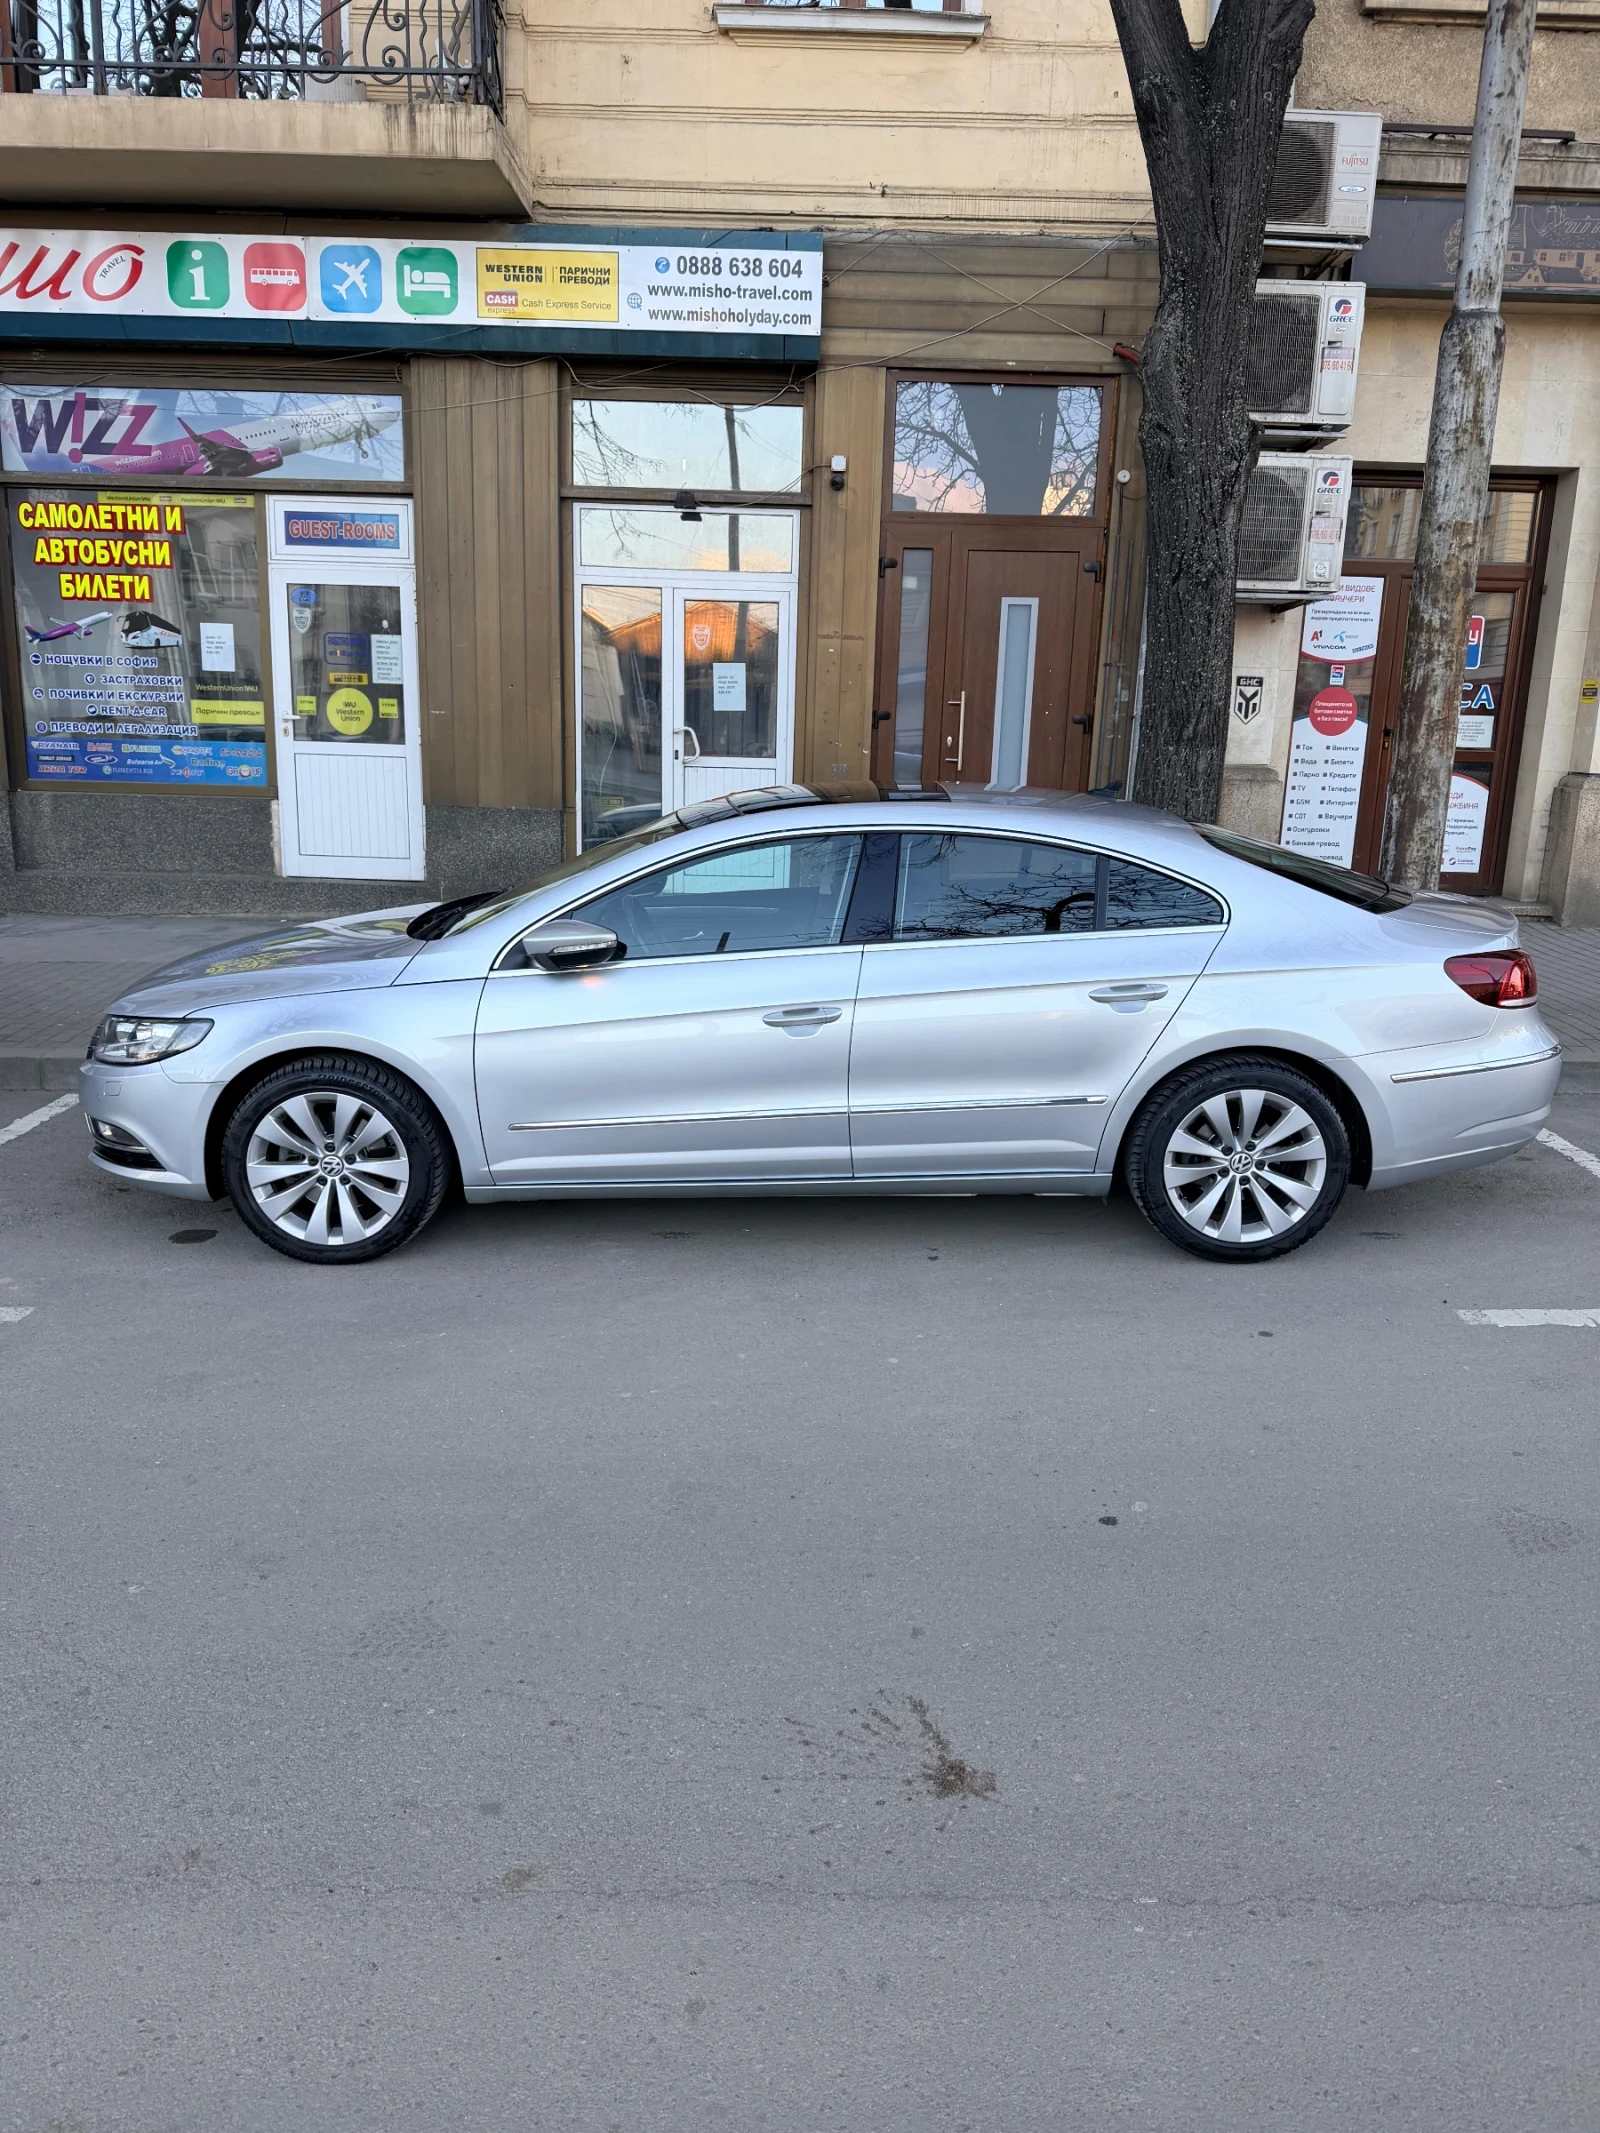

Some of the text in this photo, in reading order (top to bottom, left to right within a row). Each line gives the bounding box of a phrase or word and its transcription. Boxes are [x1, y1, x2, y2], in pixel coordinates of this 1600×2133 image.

[1342, 154, 1368, 167] FUJITSU
[99, 255, 126, 279] TRAVEL
[485, 264, 543, 274] WESTERN
[559, 266, 611, 276] ПАРИЧНИ
[676, 255, 803, 279] 0888 638 604
[503, 273, 543, 283] UNION
[559, 275, 610, 286] ПРЕВОДИ
[647, 283, 812, 301] www.misho-travel.com
[486, 294, 516, 305] CASH
[521, 299, 612, 310] Cash Express Service
[487, 307, 516, 315] express
[648, 307, 812, 327] www.mishoholyday.com
[1329, 315, 1355, 323] GREE
[18, 502, 182, 532] САМОЛЕТНИ И
[289, 519, 396, 541] GUEST-ROOMS
[34, 538, 171, 566] АВТОБУСНИ
[59, 573, 151, 600] БИЛЕТИ
[1345, 585, 1376, 593] ВИДОВЕ
[1310, 629, 1323, 641] A1
[46, 655, 157, 668] НОЩУВКИ В СОФИЯ
[101, 675, 183, 686] ЗАСТРАХОВКИ
[50, 689, 184, 702] ПОЧИВКИ И ЕКСКУРЗИИ
[101, 706, 166, 716] RENT-A-CAR
[195, 707, 229, 715] Парични
[51, 722, 197, 736] ПРЕВОДИ И ЛЕГАЛИЗАЦИЯ
[37, 741, 80, 750] RYANAIR
[1292, 826, 1330, 834] Осигуровки
